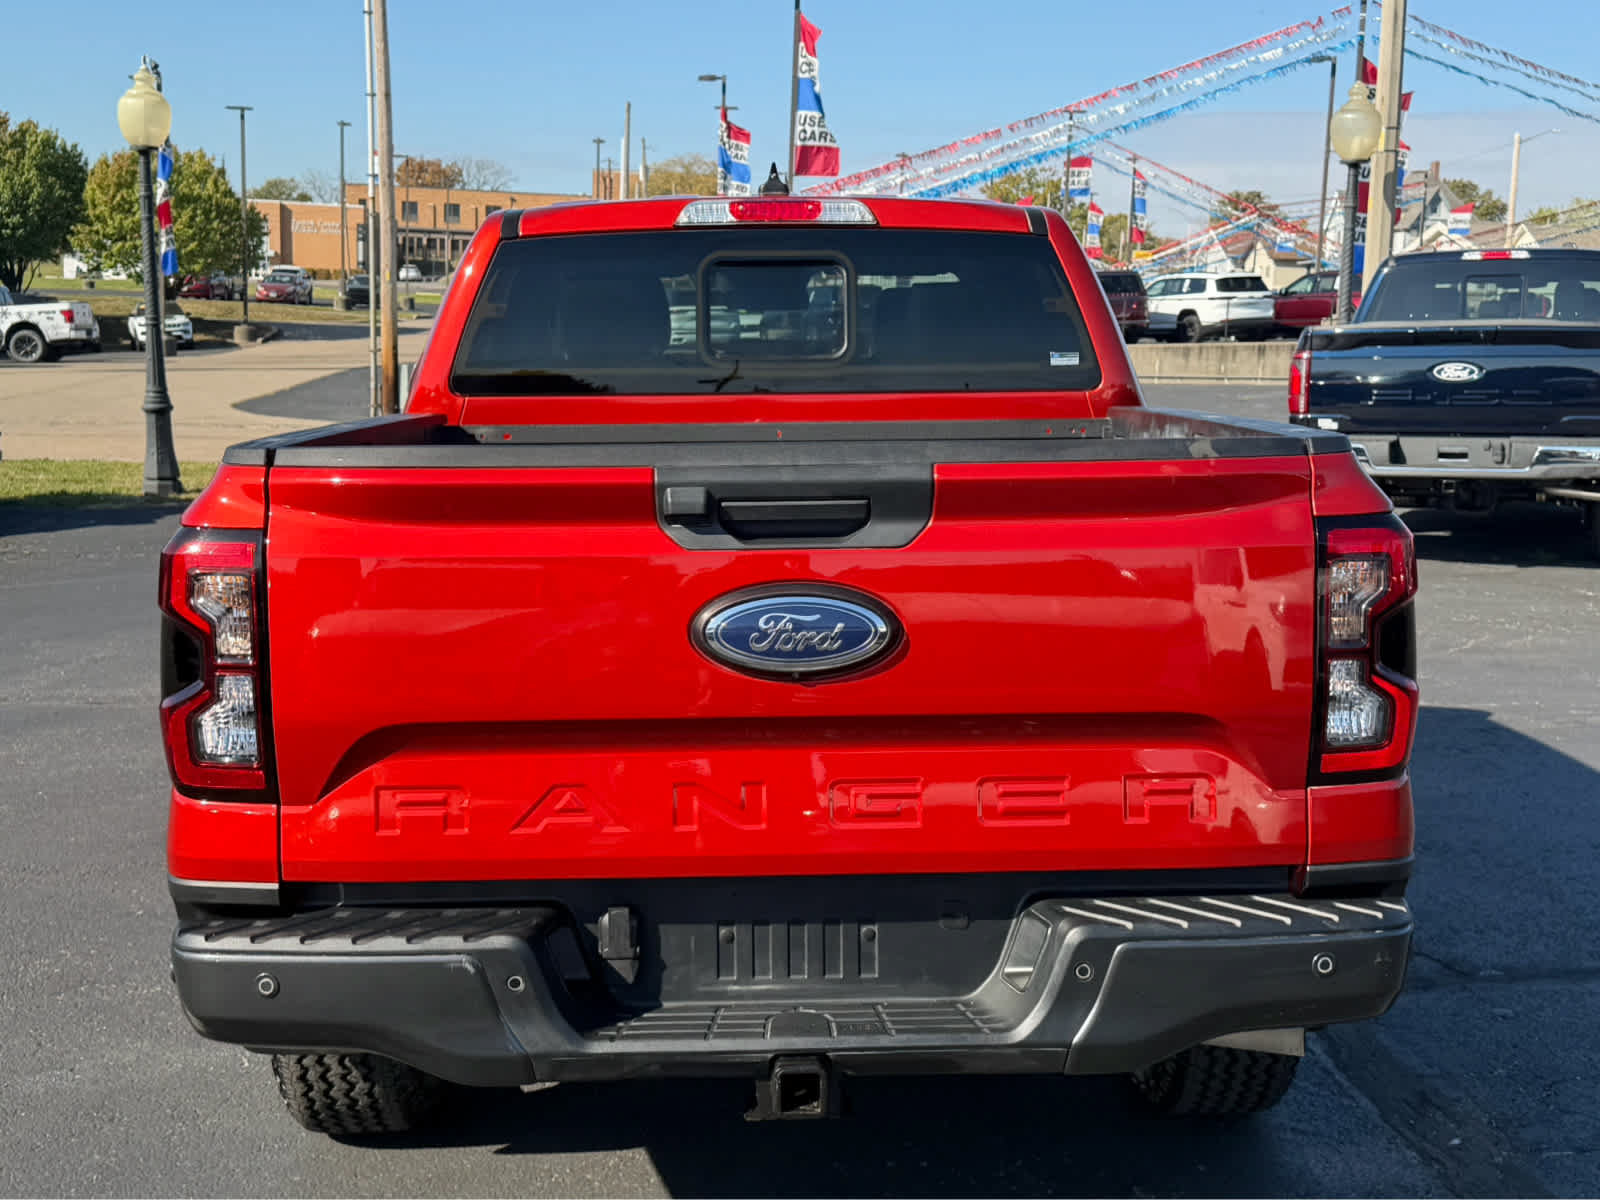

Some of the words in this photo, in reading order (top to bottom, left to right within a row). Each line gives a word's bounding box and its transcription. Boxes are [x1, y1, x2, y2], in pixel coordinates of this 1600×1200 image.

[798, 113, 827, 129] USE
[749, 611, 846, 652] Ford
[374, 772, 1218, 837] RANGER
